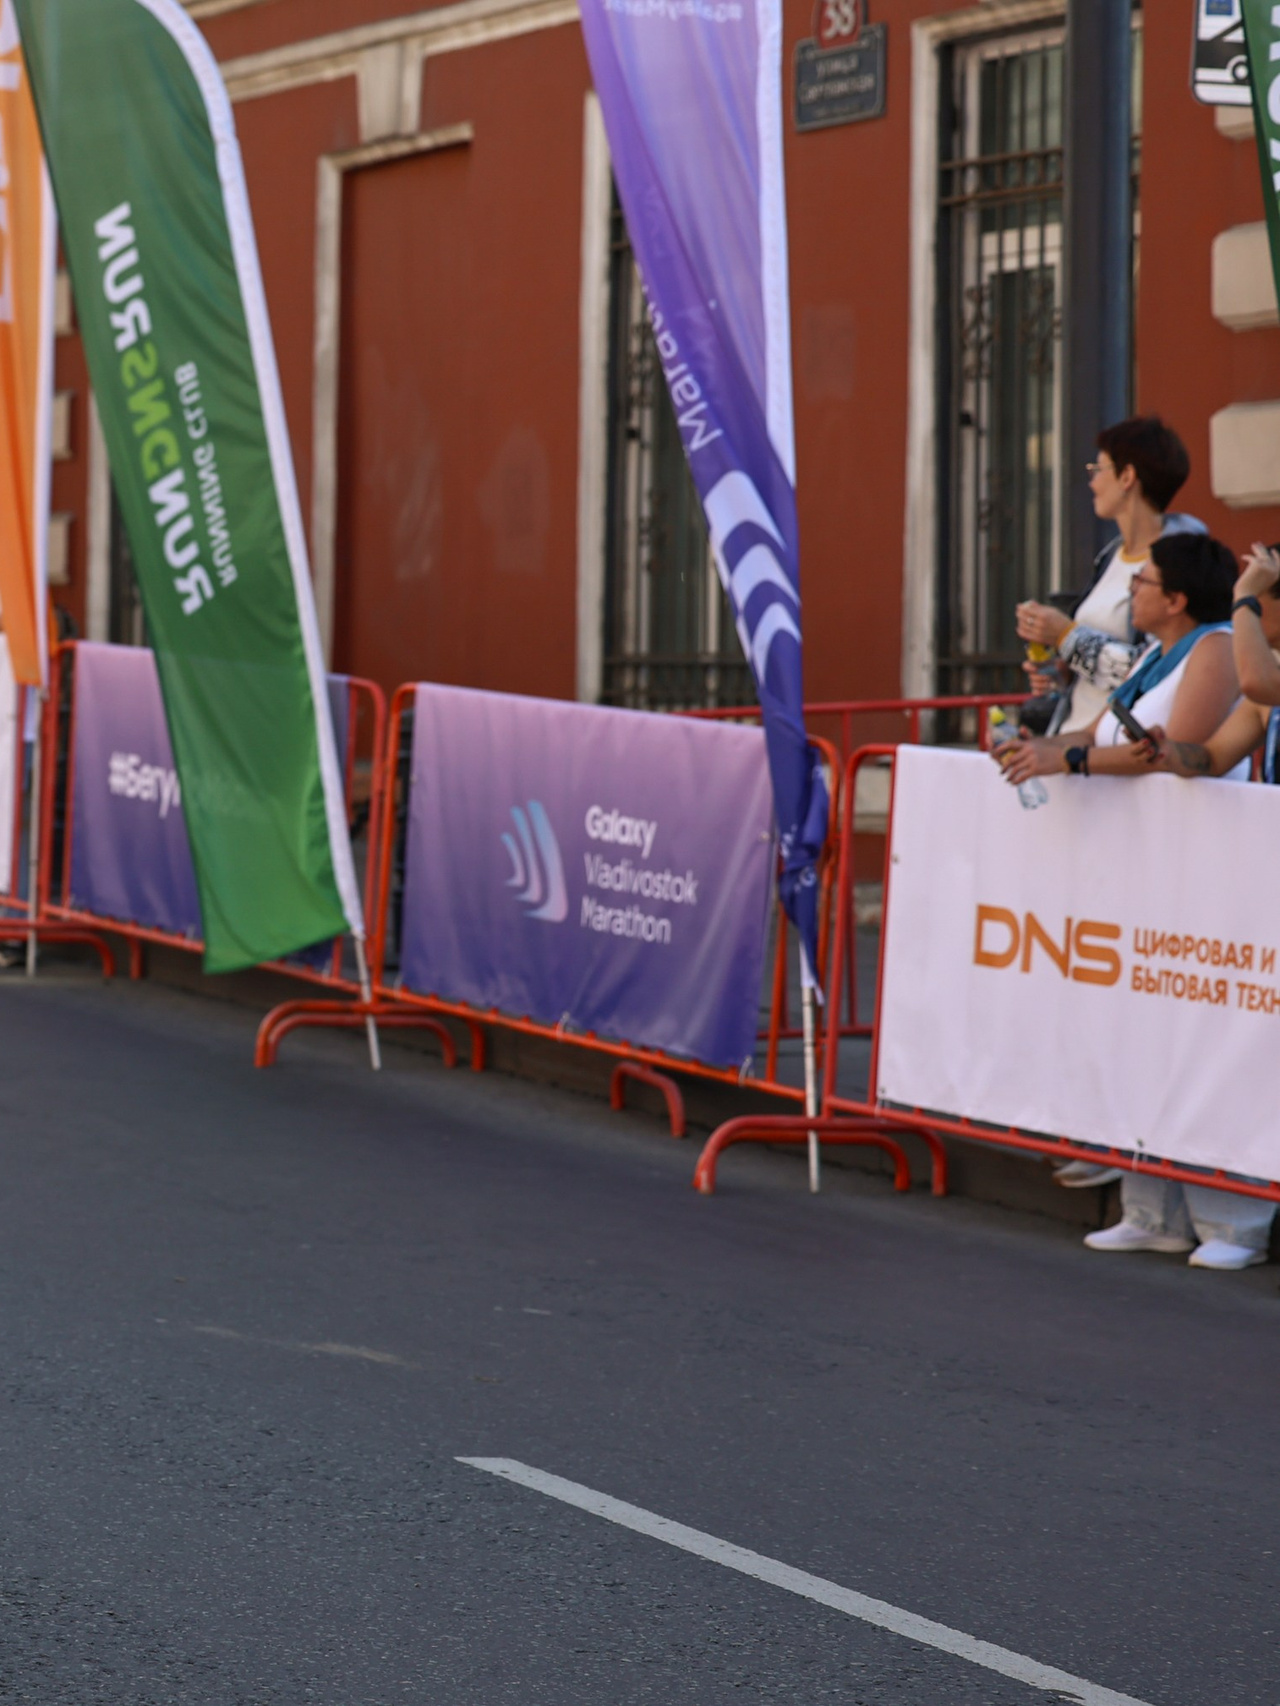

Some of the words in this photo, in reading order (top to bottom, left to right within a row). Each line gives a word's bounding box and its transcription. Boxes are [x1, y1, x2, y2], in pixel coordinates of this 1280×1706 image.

[585, 805, 658, 860] Galaxy
[583, 851, 699, 906] Vladivostok
[581, 894, 672, 935] Marathon
[973, 903, 1122, 987] DNS
[1133, 926, 1253, 971] ЦИФРОВАЯ
[1260, 947, 1276, 974] И
[1131, 965, 1228, 1006] БЫТОВАЯ
